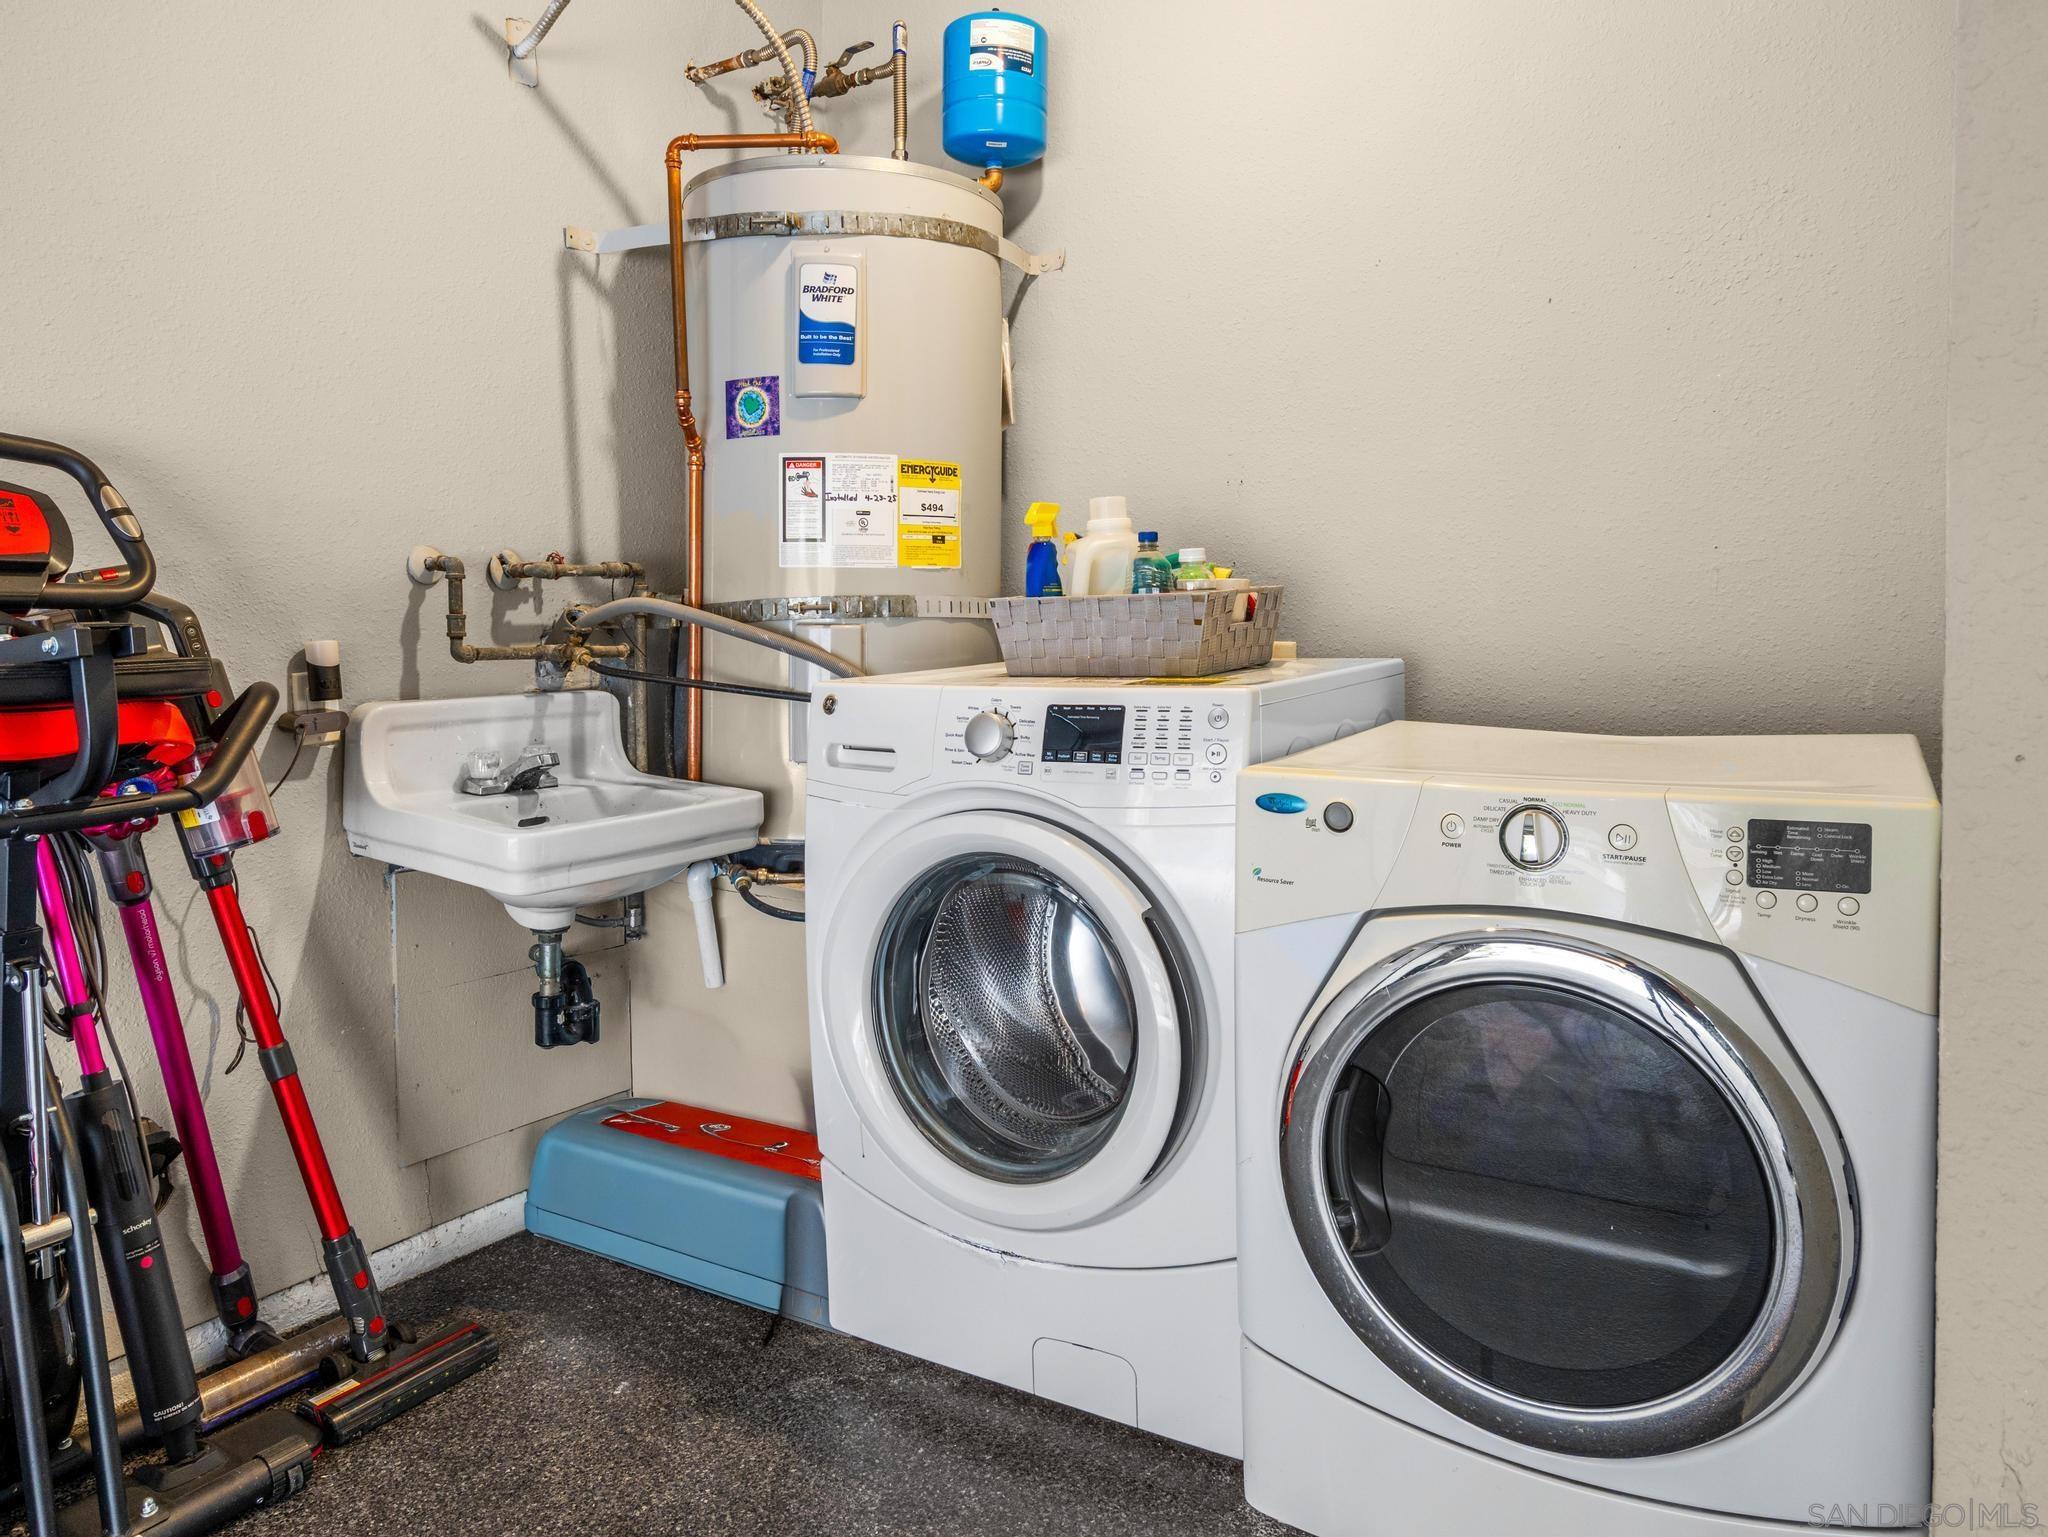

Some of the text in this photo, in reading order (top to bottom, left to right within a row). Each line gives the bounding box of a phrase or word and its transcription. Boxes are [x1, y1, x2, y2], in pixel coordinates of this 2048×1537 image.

[802, 285, 855, 295] BRADFORD
[811, 294, 843, 303] WHITE
[901, 464, 958, 477] ENERGYGUIDE
[825, 492, 858, 502] Installed
[920, 503, 944, 512] $494
[1603, 854, 1647, 862] START/PAUSE
[1257, 876, 1279, 884] Resource
[137, 909, 155, 950] motorhead
[153, 958, 163, 982] dyson
[153, 1401, 184, 1418] CAUTION!
[163, 1409, 181, 1420] SURFACE
